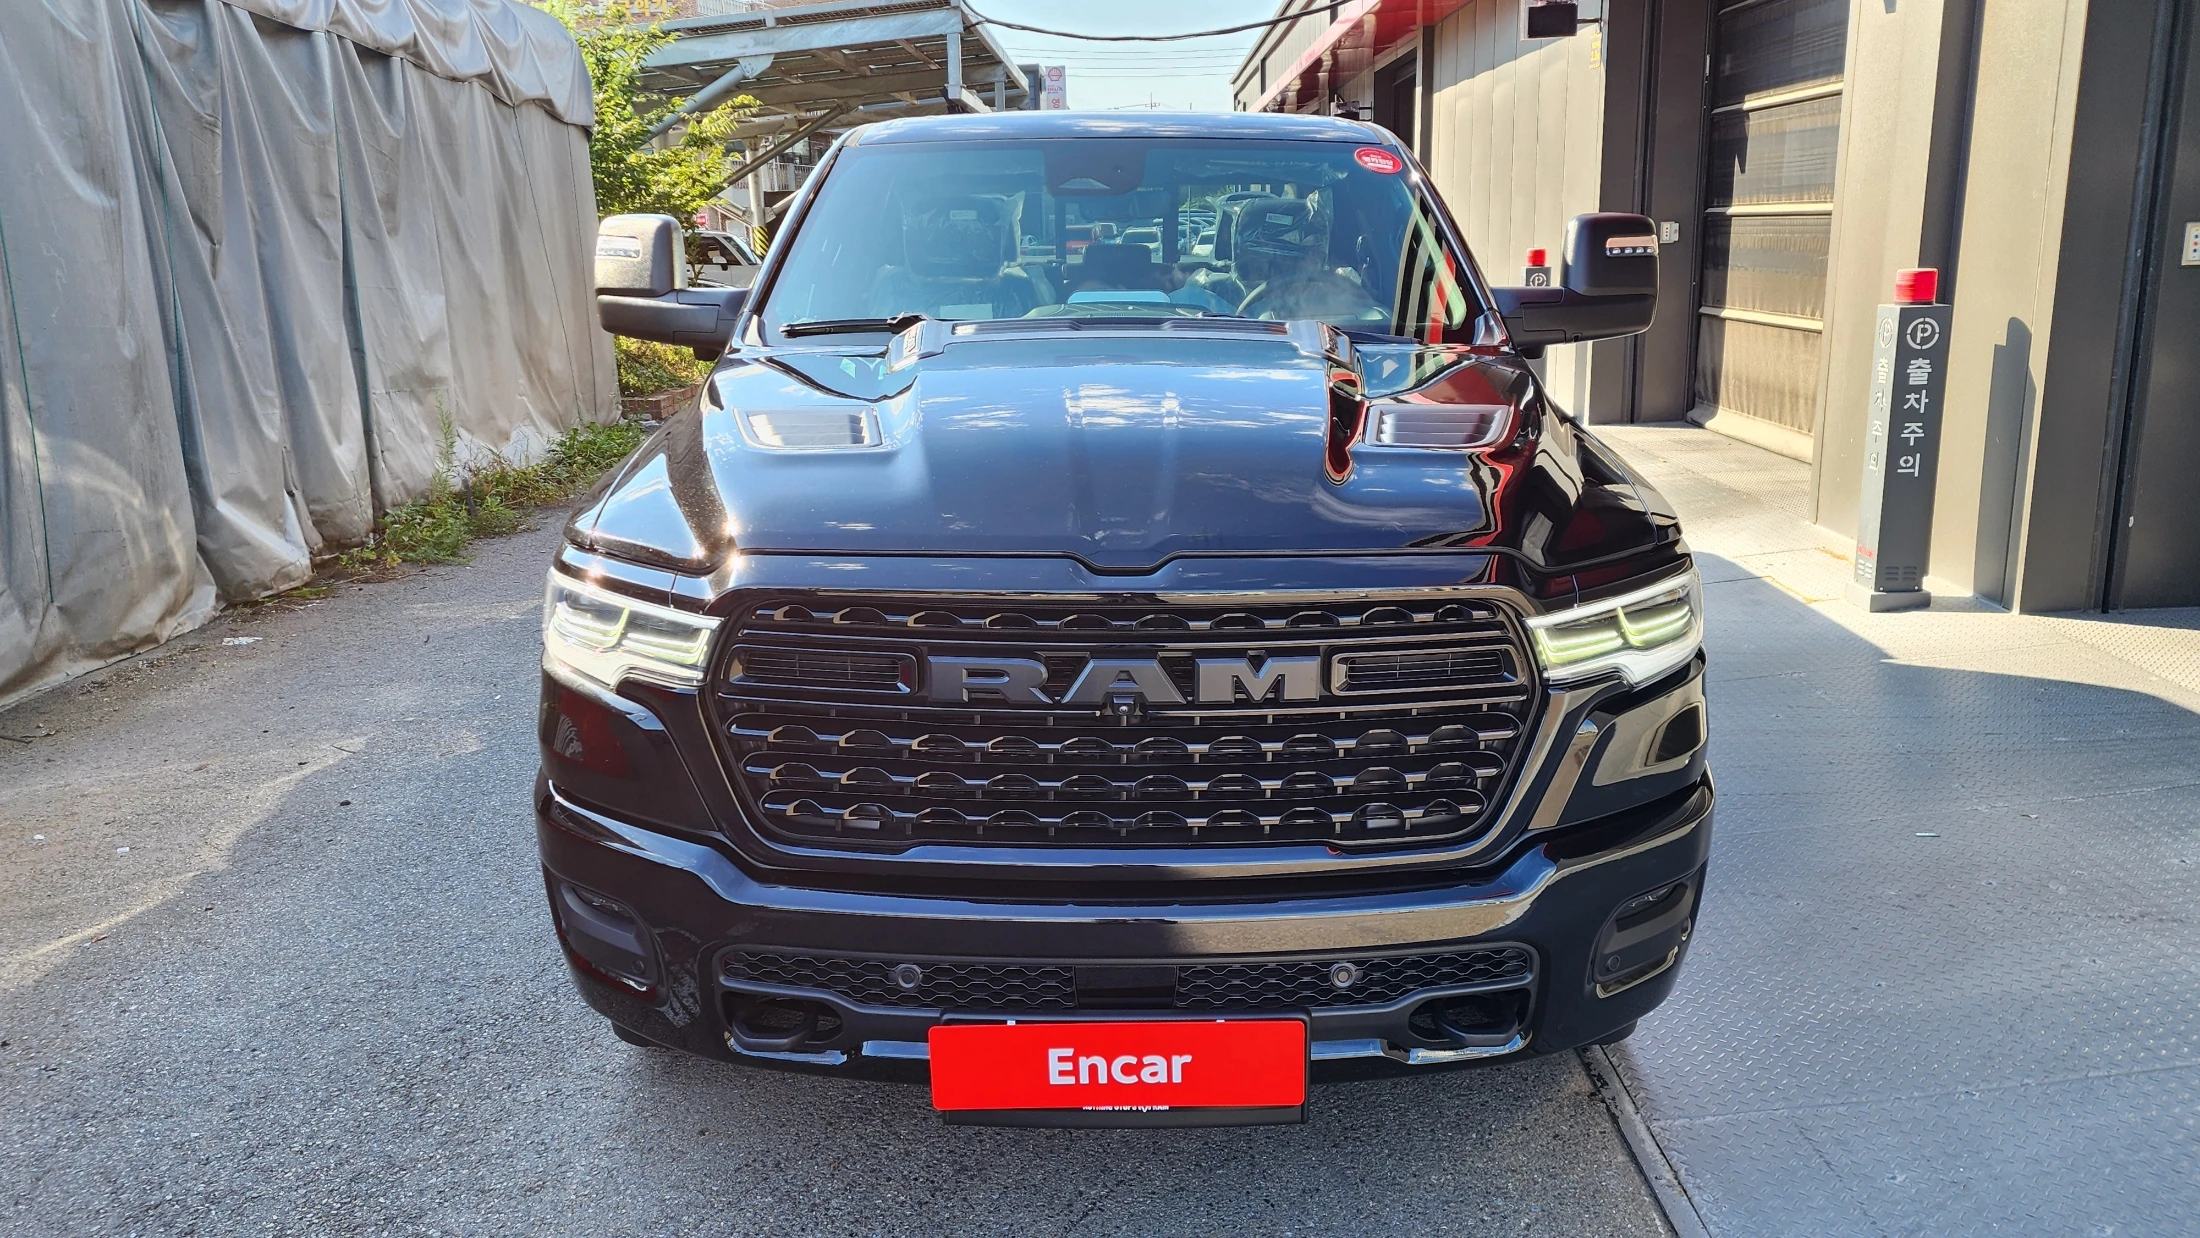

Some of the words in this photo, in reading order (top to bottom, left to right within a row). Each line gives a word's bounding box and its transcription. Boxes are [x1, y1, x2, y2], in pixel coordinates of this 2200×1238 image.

[1897, 357, 1932, 477] 출차주의
[927, 655, 1321, 704] RAM
[1048, 1047, 1192, 1085] Encar
